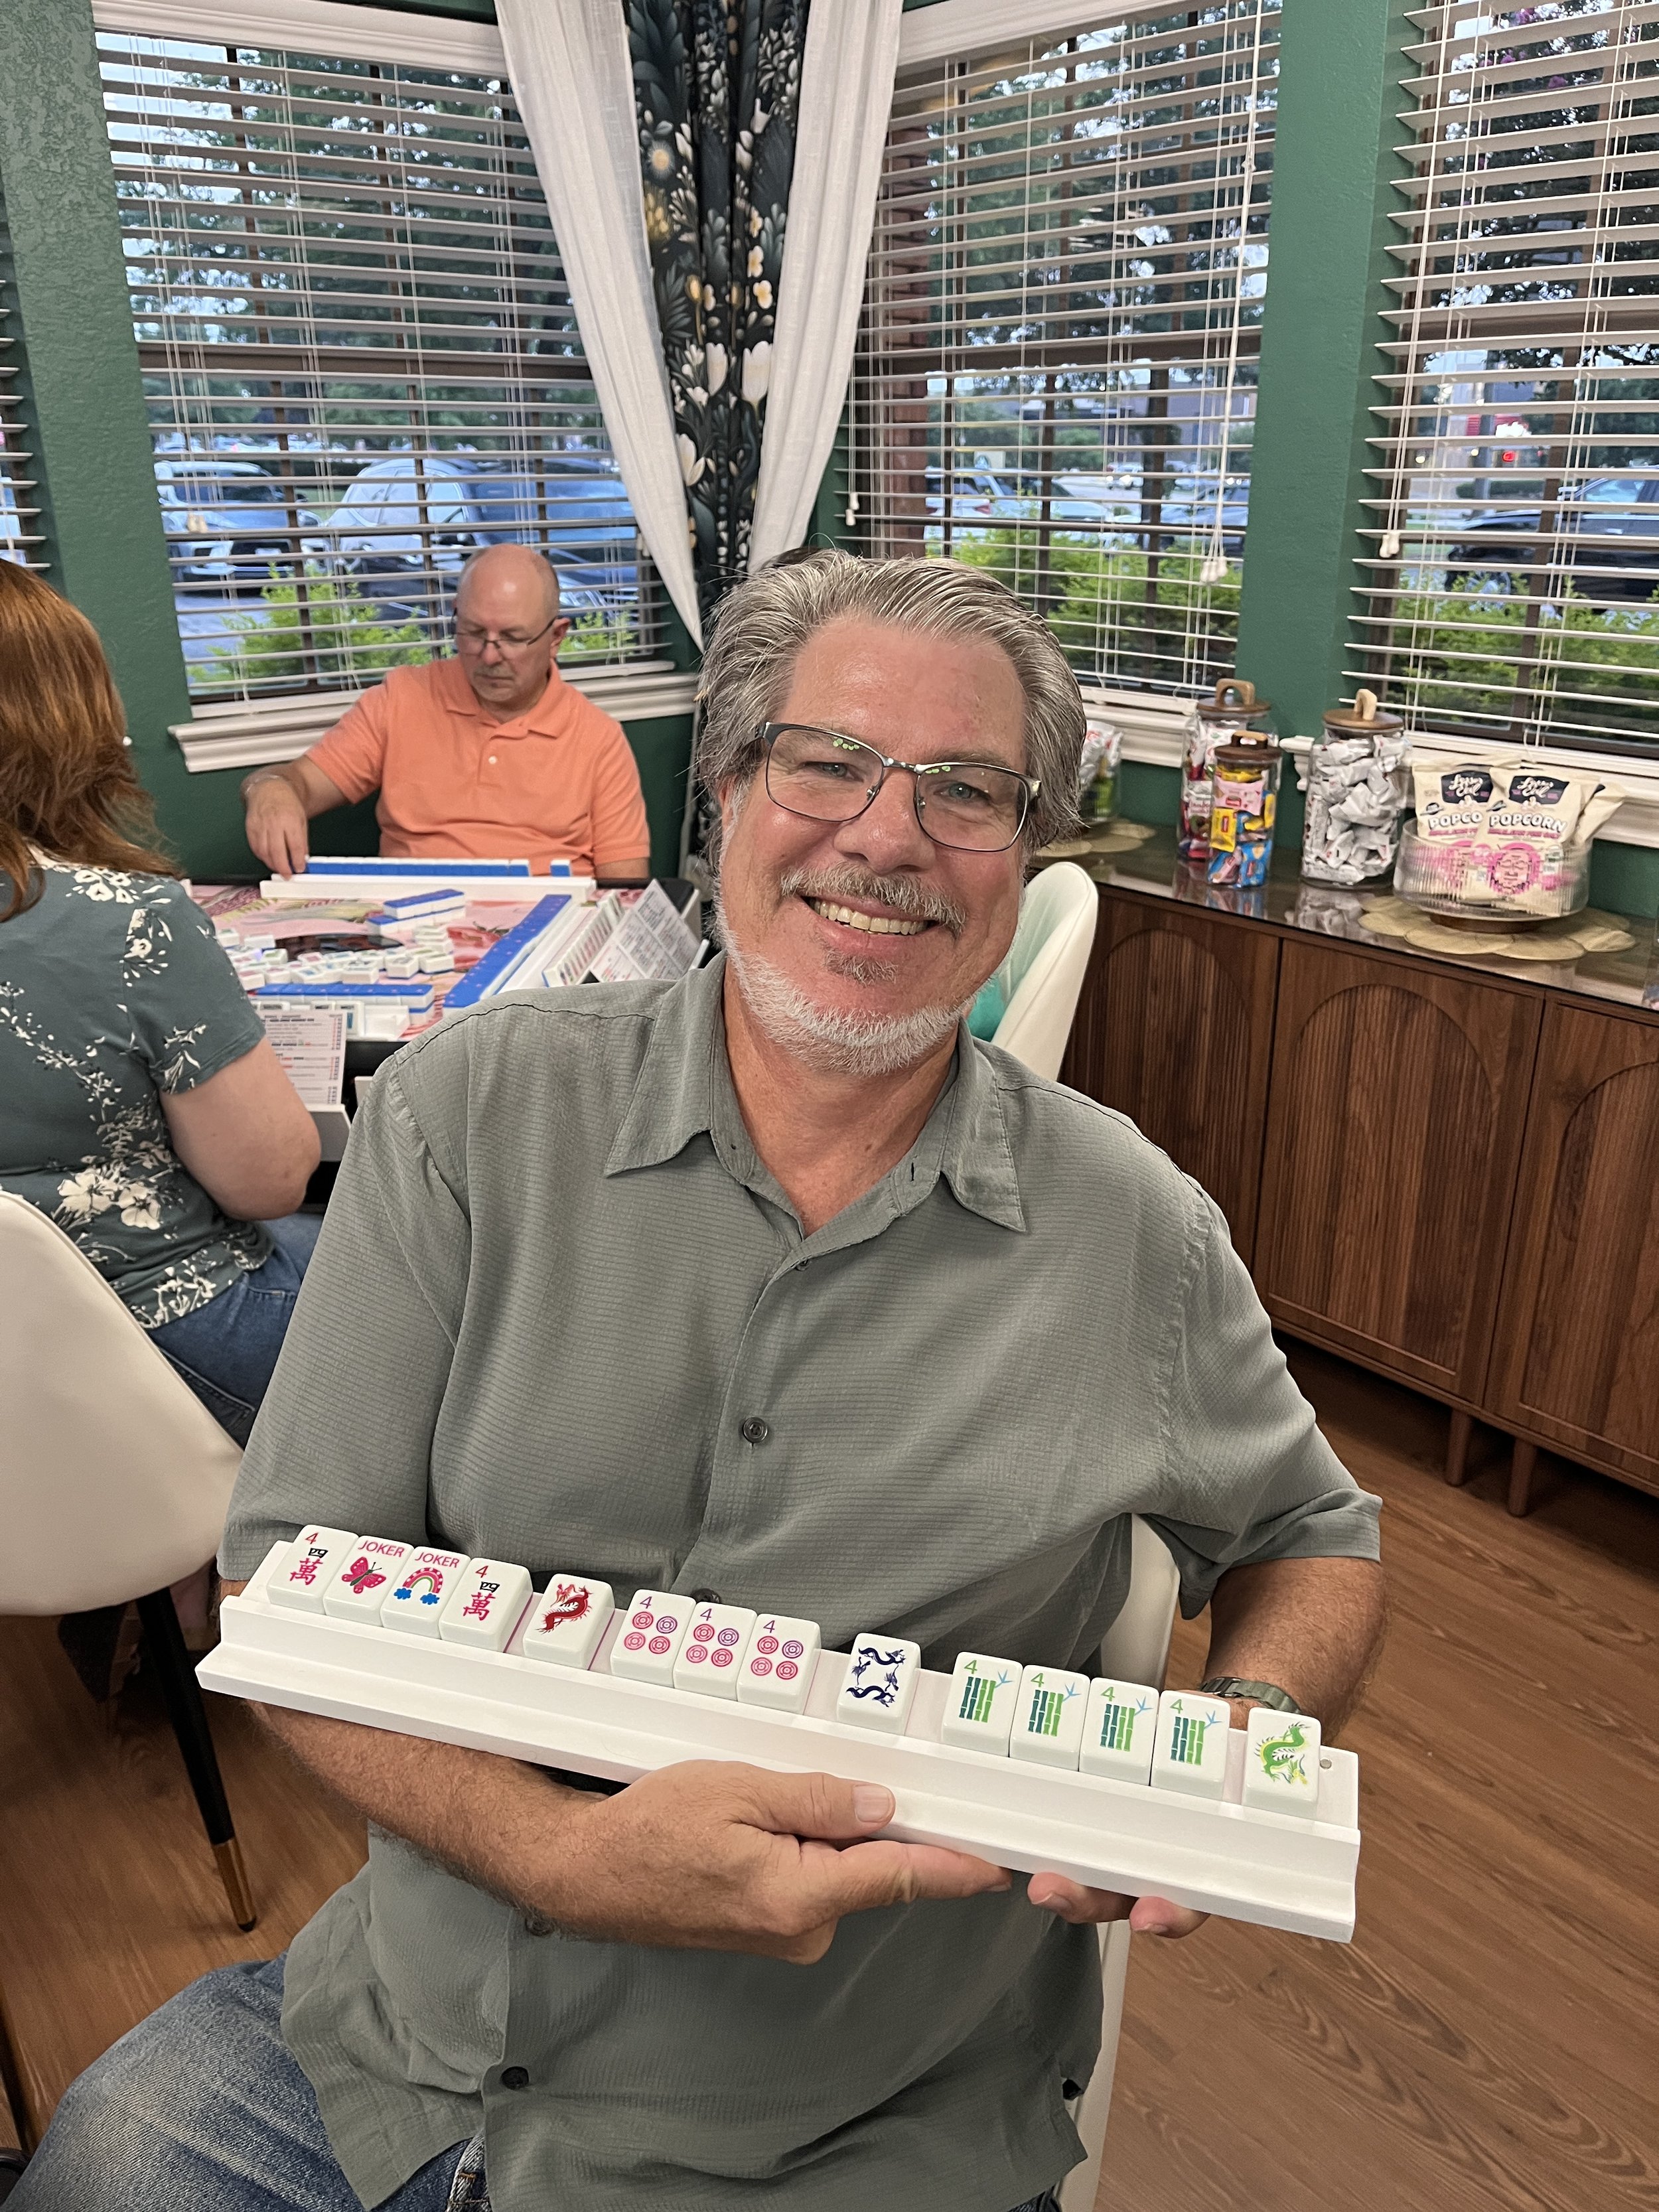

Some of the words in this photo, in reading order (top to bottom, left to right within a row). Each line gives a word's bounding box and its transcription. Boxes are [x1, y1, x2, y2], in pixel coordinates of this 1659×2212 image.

[1428, 812, 1483, 830] POPCO
[1489, 812, 1567, 834] POPCORN
[305, 1532, 319, 1544] 4
[358, 1540, 404, 1558] JOKER
[415, 1552, 459, 1568] JOKER
[475, 1566, 488, 1578] 4
[640, 1596, 652, 1609] 4
[700, 1609, 712, 1621] 4
[763, 1620, 775, 1633] 4
[964, 1660, 977, 1674] 4
[1031, 1673, 1045, 1687] 4
[1102, 1687, 1115, 1701] 4
[1171, 1699, 1183, 1714] 4
